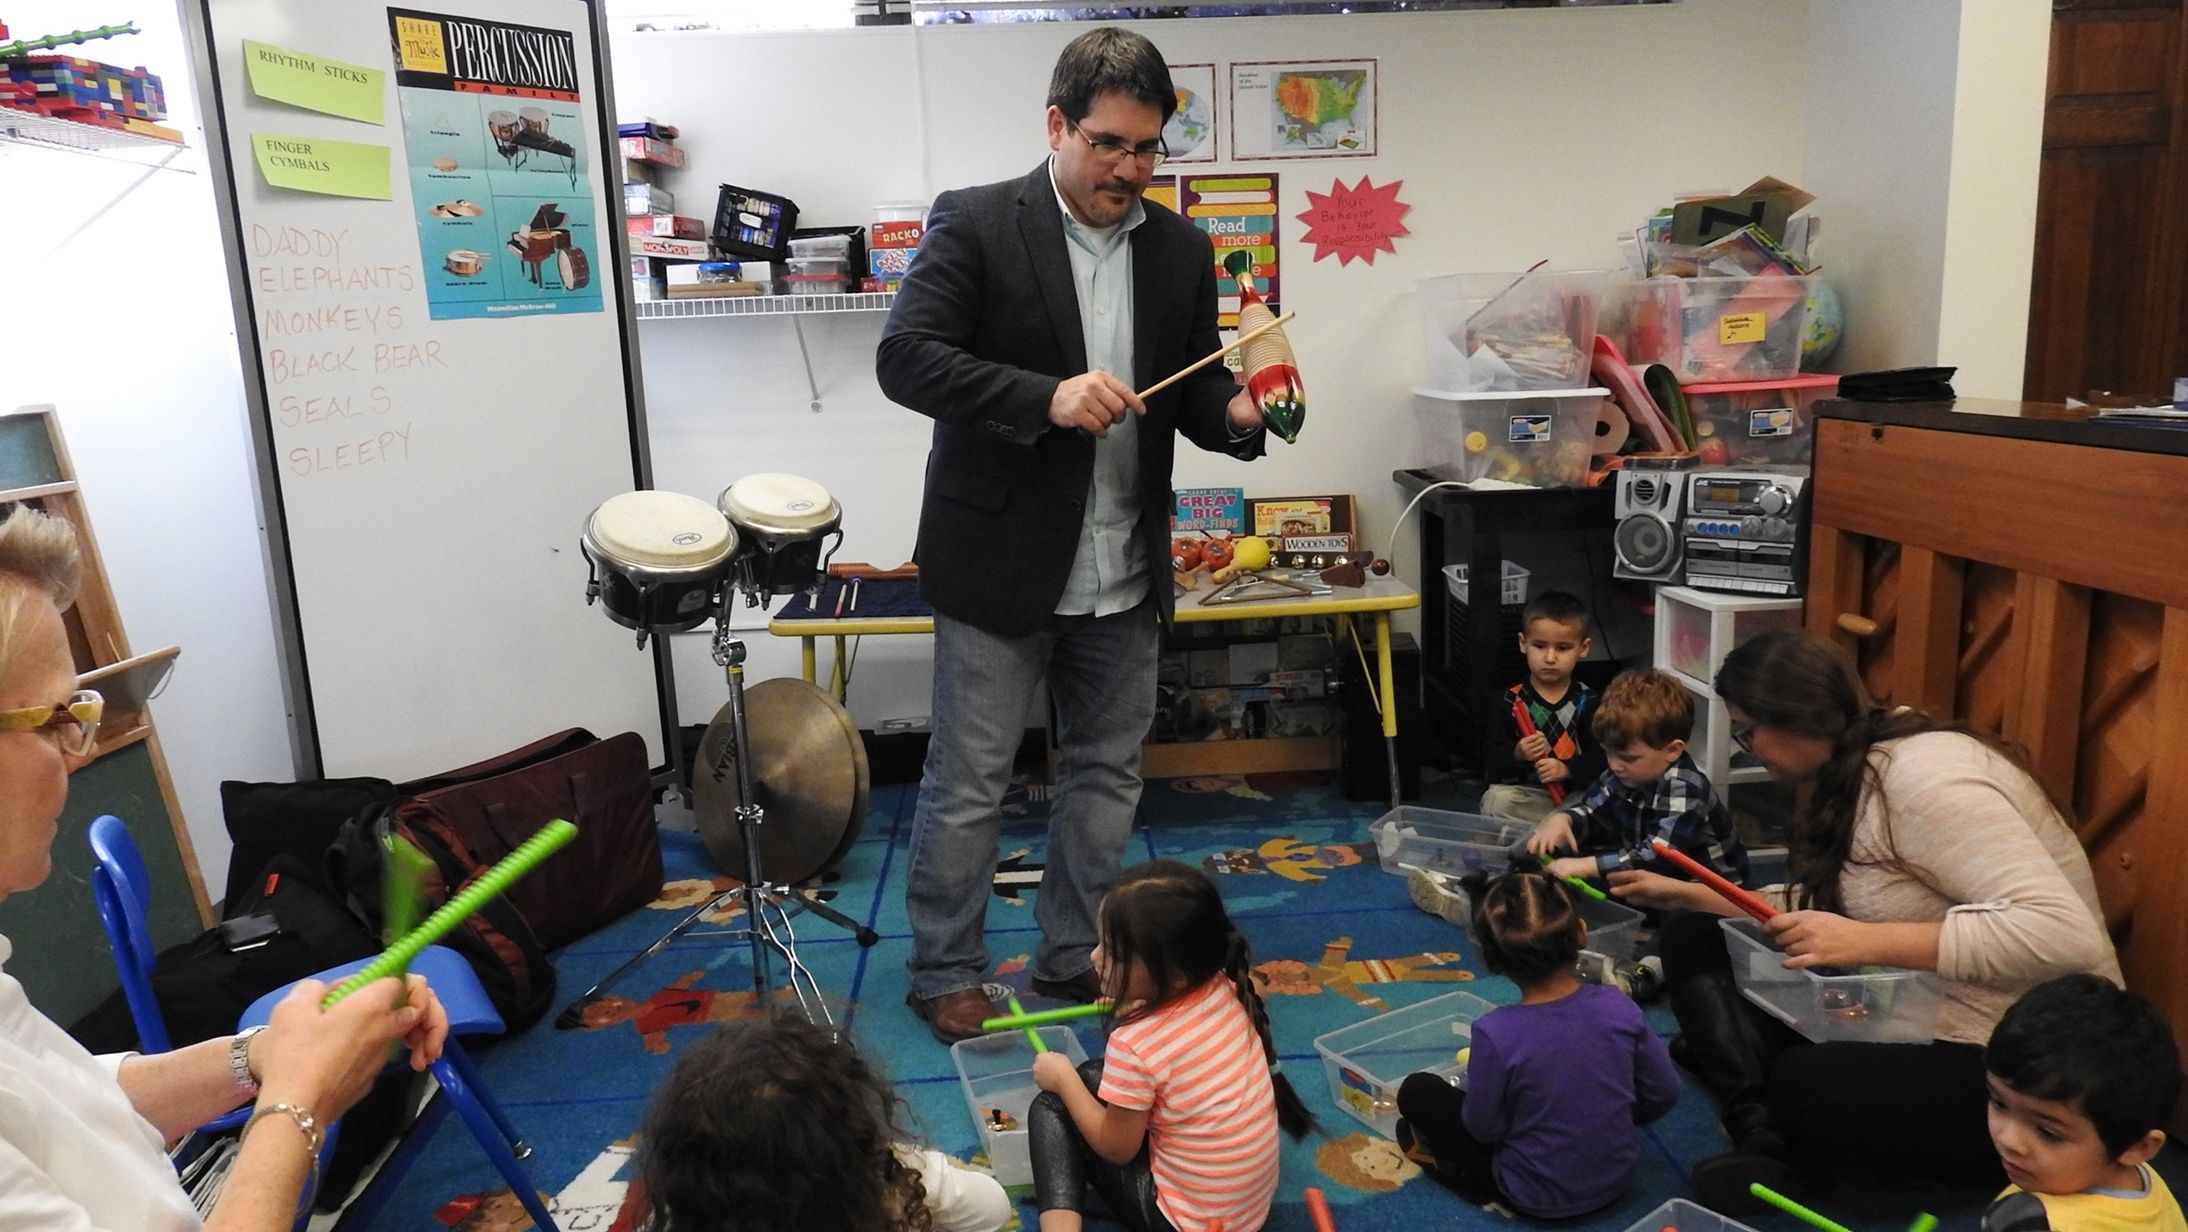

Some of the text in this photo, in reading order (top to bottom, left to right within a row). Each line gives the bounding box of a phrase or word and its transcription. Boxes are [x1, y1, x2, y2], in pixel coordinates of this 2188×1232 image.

[402, 21, 437, 37] SHARE
[446, 20, 576, 90] PERCUSSION
[258, 49, 369, 85] RHYTHM STICKS
[460, 83, 575, 101] FAMILY
[266, 139, 314, 156] FINGER
[270, 155, 331, 173] CYMBALS
[1208, 216, 1246, 234] Read
[252, 223, 348, 263] DADDY
[1222, 235, 1261, 246] more
[258, 265, 415, 294] ELEPHANTS
[264, 304, 403, 340] MONKEYS
[268, 339, 448, 385] BLACK BEAR
[289, 421, 413, 477] SLEEPY
[1179, 495, 1237, 507] GREAT
[1192, 507, 1223, 519] BIG
[1257, 505, 1289, 516] Know
[1177, 518, 1239, 530] WORD-FINDS
